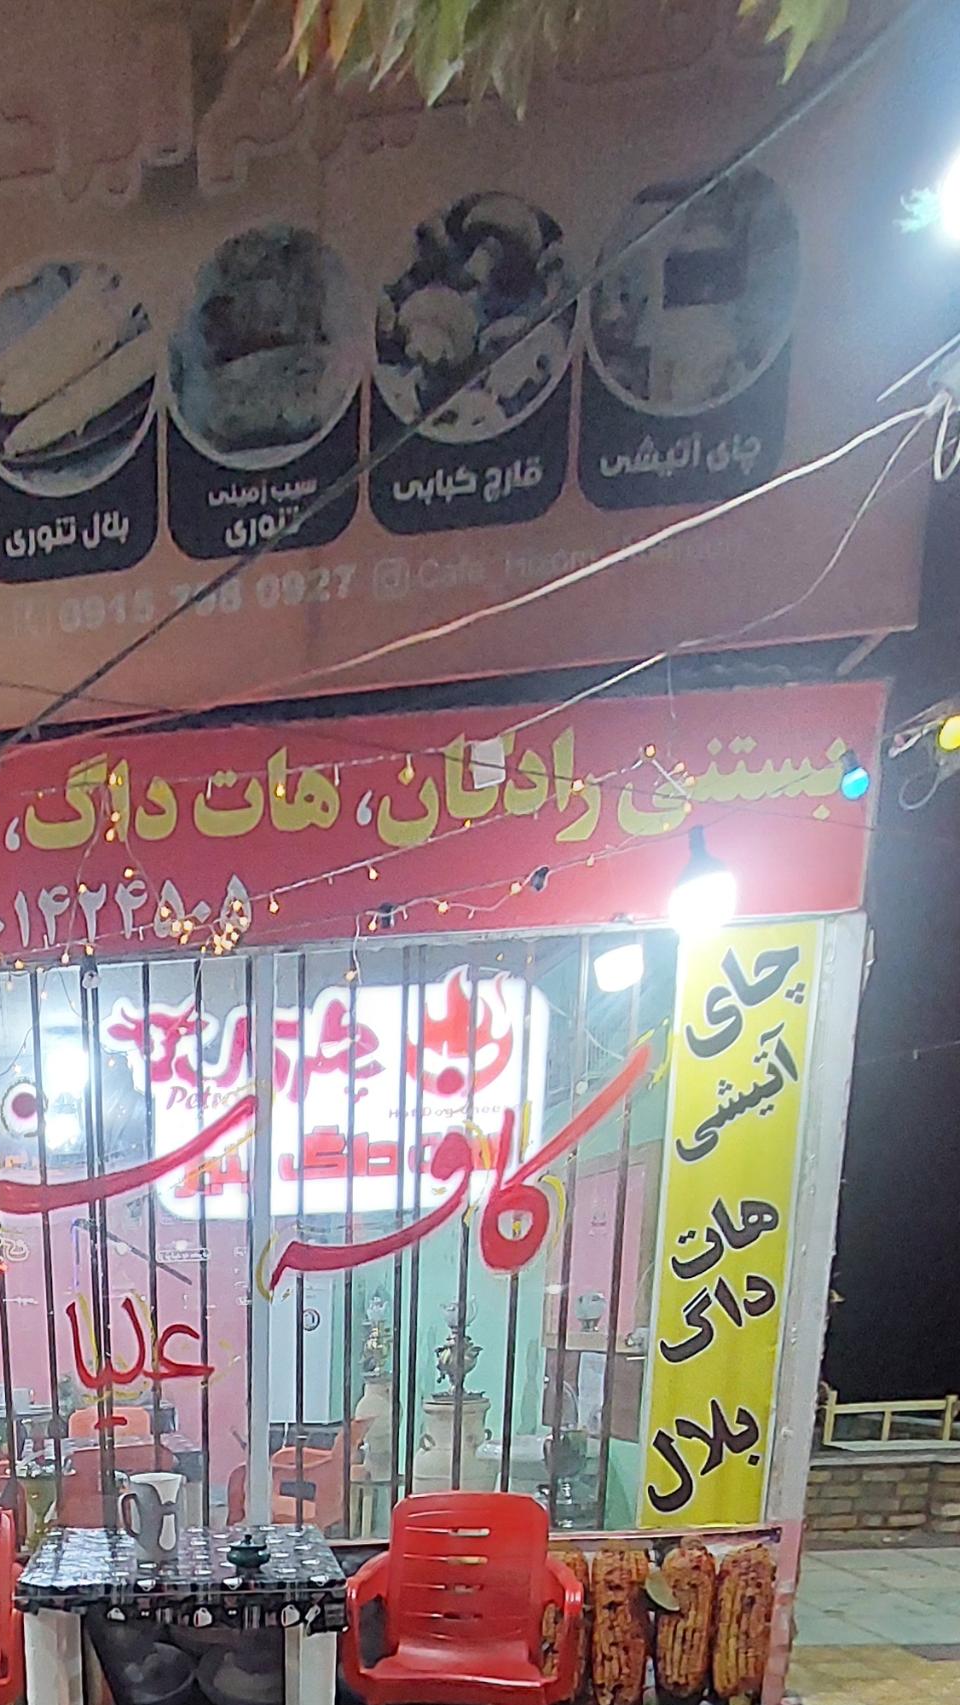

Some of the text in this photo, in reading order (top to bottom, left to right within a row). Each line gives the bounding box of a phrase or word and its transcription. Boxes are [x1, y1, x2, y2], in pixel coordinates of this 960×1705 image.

[207, 477, 318, 507] سیب زمینی
[392, 455, 544, 506] قارچ کبابی
[706, 433, 763, 475] چای
[5, 509, 130, 559] بلال تنوری
[224, 505, 302, 549] تنوری
[193, 745, 341, 838] هات
[616, 734, 848, 837] بستنی
[684, 943, 808, 1060] چای
[673, 1020, 800, 1164] آتیشی
[670, 1196, 782, 1282] هات
[658, 1275, 777, 1366] داگ
[646, 1397, 761, 1516] بلال
